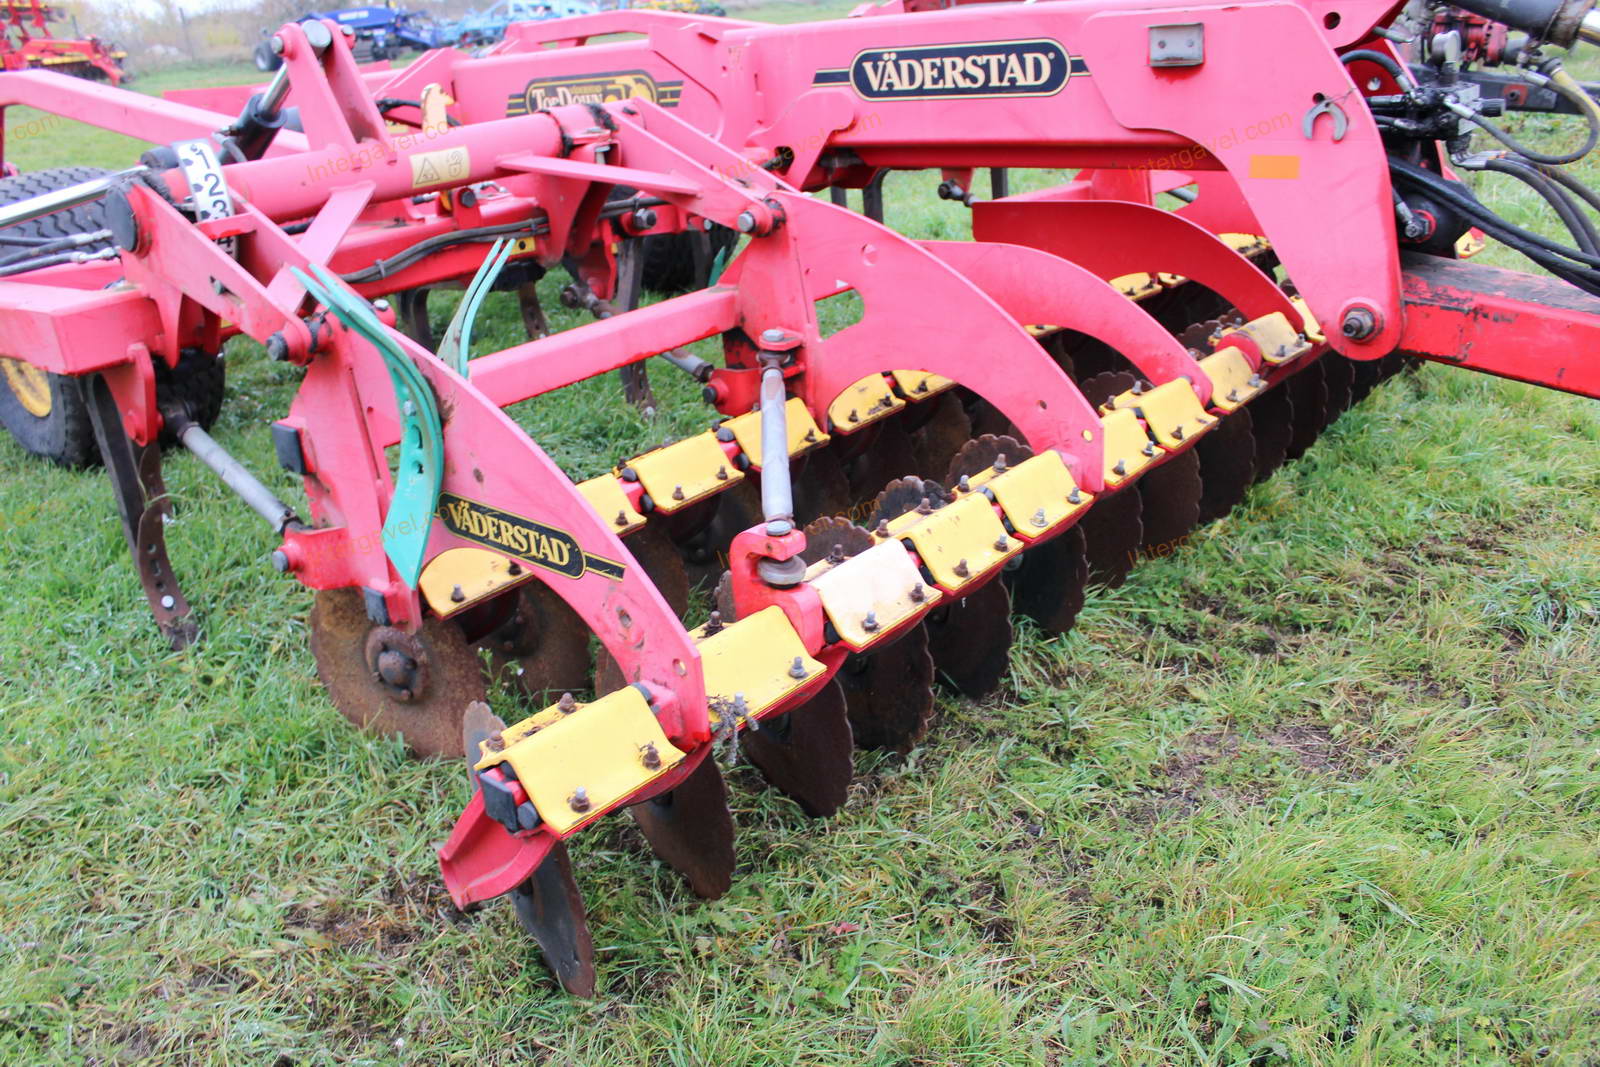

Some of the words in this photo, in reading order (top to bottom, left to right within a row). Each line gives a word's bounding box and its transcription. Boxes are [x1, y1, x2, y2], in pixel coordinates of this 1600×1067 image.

[862, 52, 1054, 91] VÄDERSTAD
[204, 173, 224, 196] 2
[448, 501, 572, 566] VÄDERSTAD
